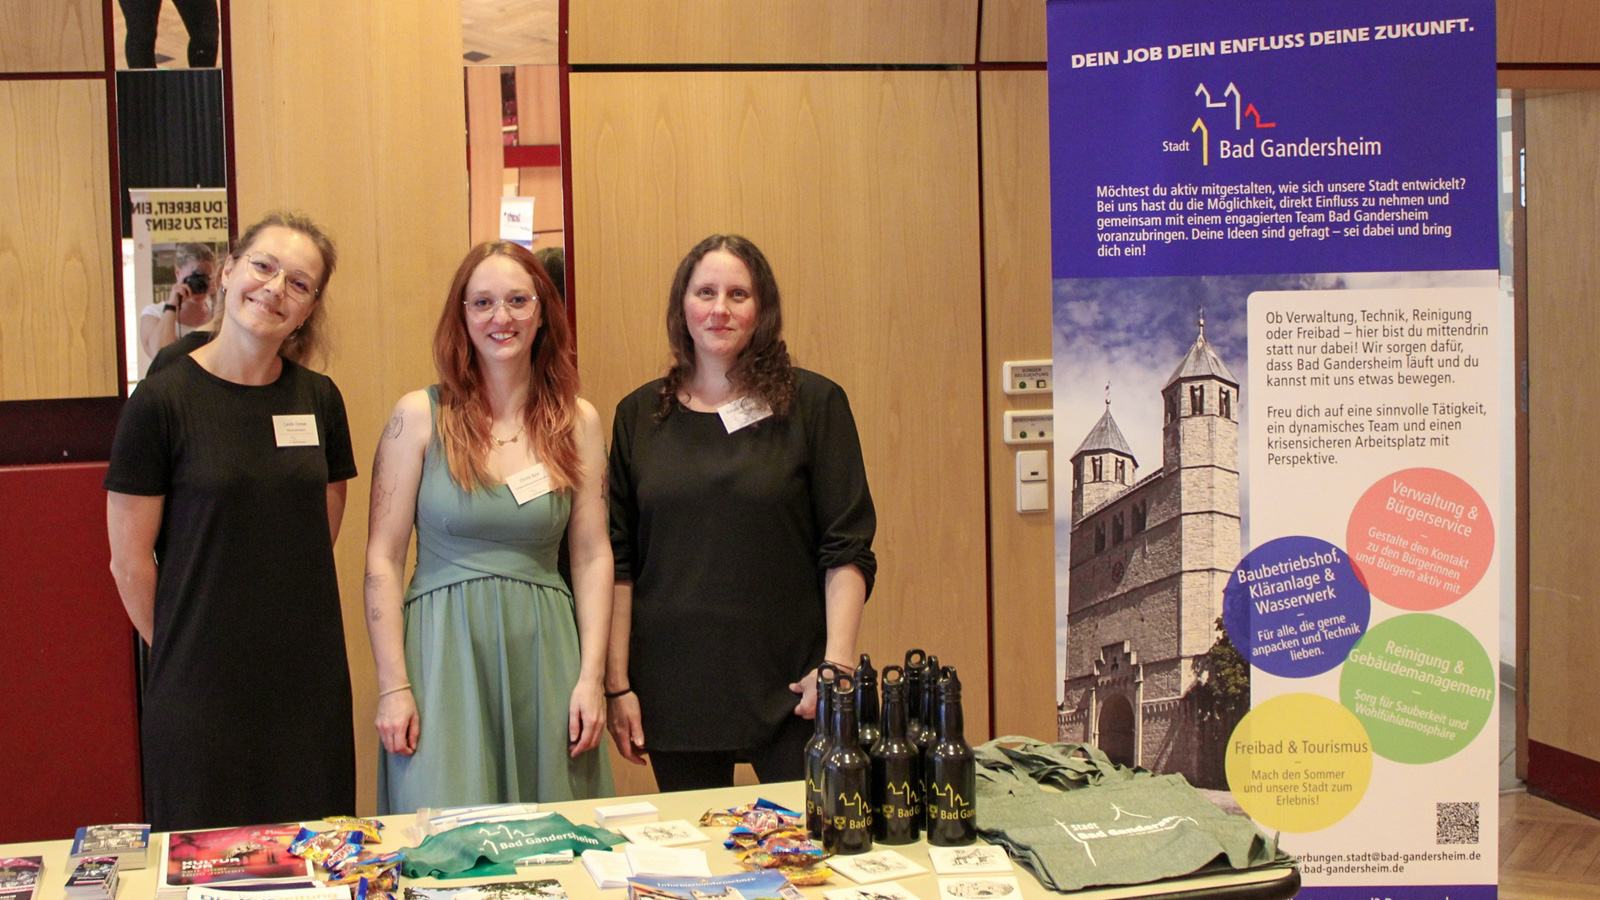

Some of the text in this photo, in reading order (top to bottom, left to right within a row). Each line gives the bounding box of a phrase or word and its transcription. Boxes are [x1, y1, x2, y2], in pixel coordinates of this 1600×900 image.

[1071, 18, 1474, 68] DEIN JOB DEIN ENFLUSS DEINE ZUKUNFT.
[1162, 140, 1189, 152] Stadt
[1220, 136, 1381, 158] Bad Gandersheim
[1096, 177, 1466, 199] Möchtest du aktiv mitgestalten, wie sich unsere Stadt entwickelt?
[1097, 192, 1449, 213] Bei uns hast du die Möglichkeit, direkt Einfluss zu nehmen und
[1096, 208, 1428, 230] gemeinsam mit einem engagierten Team Bad Gandersheim
[1096, 222, 1451, 243] voranzubringen. Deine Ideen sind gefragt sei dabei und bring
[1097, 243, 1146, 257] dich ein!
[1265, 308, 1471, 325] Ob Verwaltung, Technik, Reinigung
[1266, 322, 1488, 340] oder Freibad hier bist du mittendrin
[1266, 338, 1463, 356] statt nur dabei! Wir sorgen dafür,
[1266, 354, 1478, 371] dass Bad Gandersheim läuft und du
[1266, 371, 1455, 387] kannst mit uns etwas bewegen.
[1267, 401, 1486, 418] Freu dich auf eine sinnvolle Tätigkeit,
[1267, 416, 1461, 436] ein dynamisches Team und einen
[1267, 433, 1449, 450] krisensicheren Arbeitsplatz mit
[1267, 451, 1337, 468] Perspektive.
[1393, 481, 1478, 520] Verwaltung &
[1385, 496, 1472, 537] Bürgerservice
[1368, 526, 1469, 569] Gestalte den Kontakt
[1237, 547, 1342, 584] Baubetriebshof,
[1366, 541, 1460, 580] zu den Bürgerinnen
[1355, 552, 1461, 594] und Bürgern aktiv mit.
[1249, 567, 1335, 601] Kläranlage &
[1254, 585, 1336, 615] Wasserwerk
[1257, 614, 1346, 642] Für alle, die gerne
[1252, 623, 1360, 656] anpacken und Technik
[1289, 647, 1324, 661] lieben.
[1385, 640, 1464, 675] Reinigung &
[1349, 649, 1493, 701] Gebäudemanagement
[1354, 688, 1469, 730] Sorg für Sauberkeit und
[1355, 702, 1456, 740] Wohlfühlatmosphäre
[1235, 739, 1368, 755] Freibad & Tourismus
[1251, 769, 1345, 780] Mach den Sommer
[1243, 781, 1352, 793] und unsere Stadt zum
[1276, 794, 1319, 805] Erlebnis!
[898, 807, 914, 818] Bad
[941, 810, 958, 820] Bad
[850, 819, 866, 829] Bad
[1071, 822, 1099, 831] Stadt
[500, 838, 522, 850] Bad
[526, 832, 599, 846] Gandersheim
[182, 858, 240, 866] KULTUR
